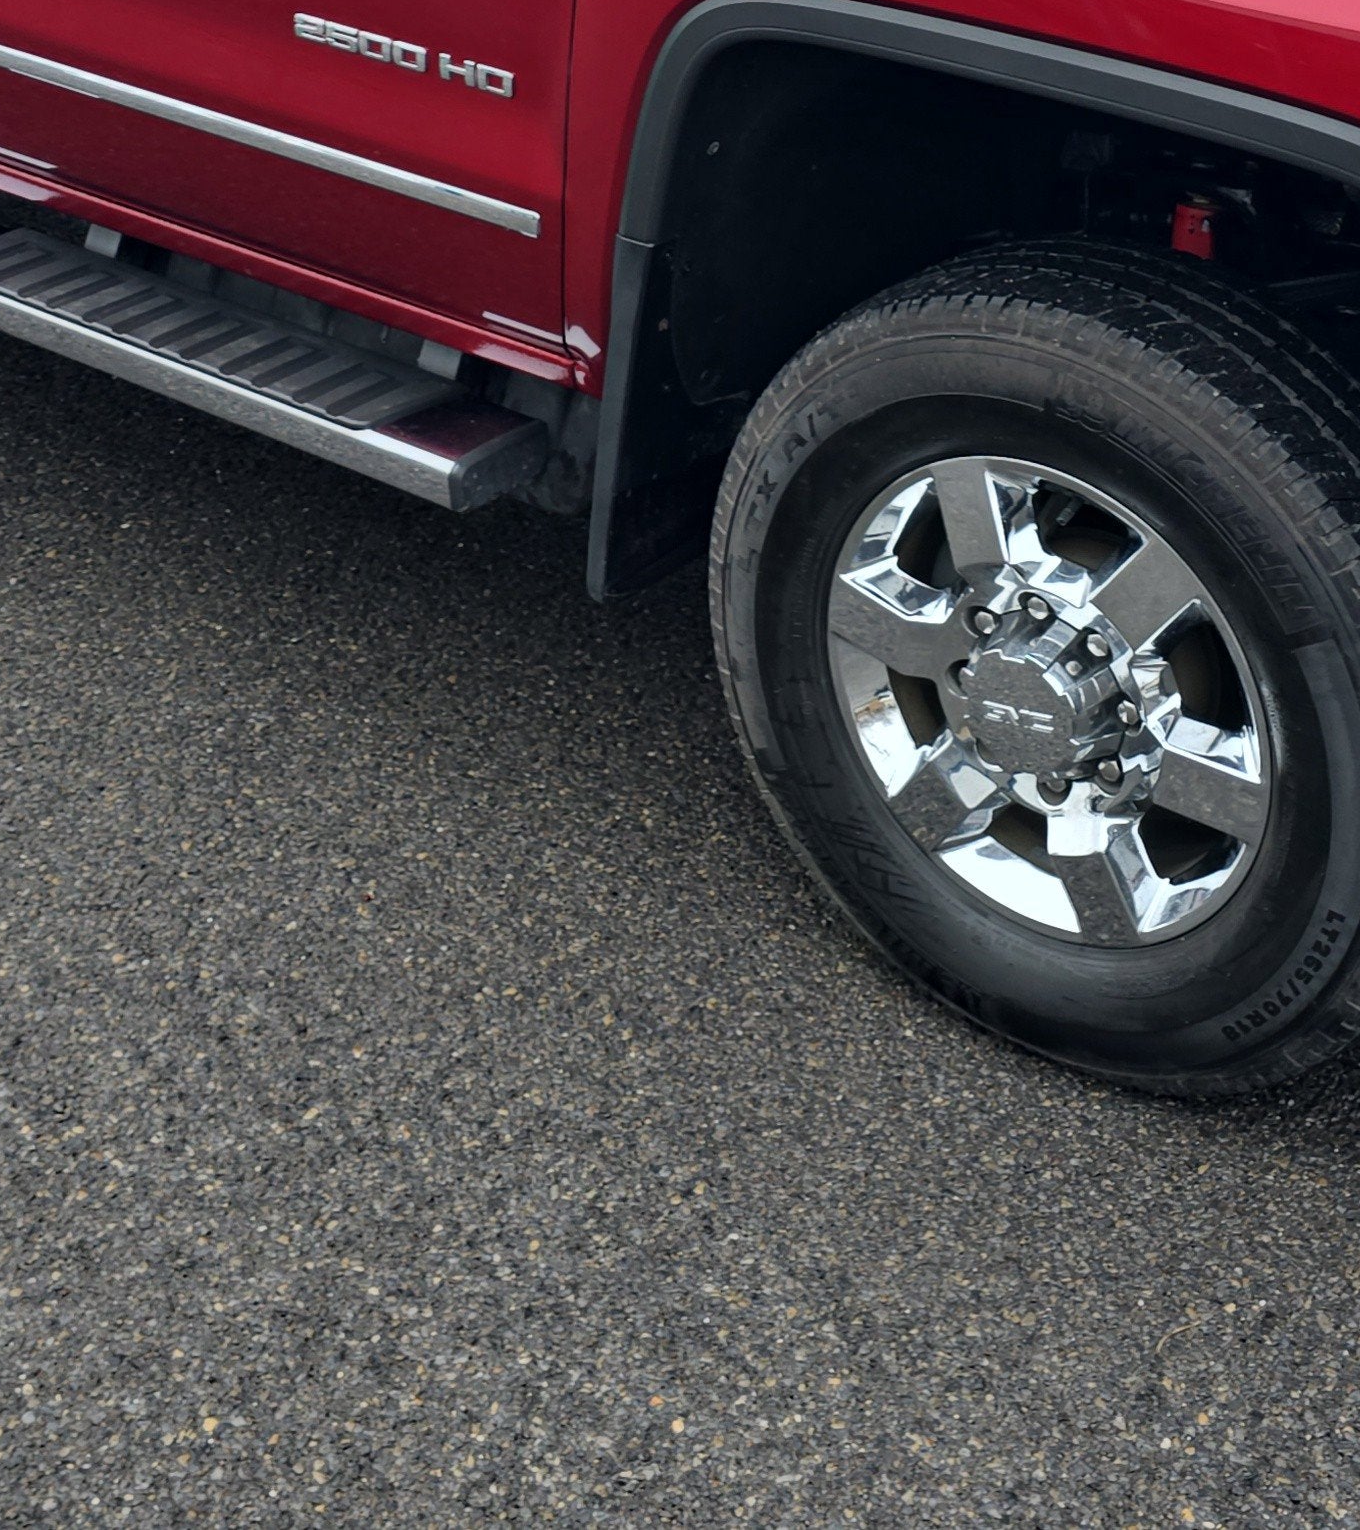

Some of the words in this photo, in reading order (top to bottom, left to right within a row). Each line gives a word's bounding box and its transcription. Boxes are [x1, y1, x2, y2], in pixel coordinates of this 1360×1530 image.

[293, 11, 428, 74] 2500
[438, 52, 515, 99] HD
[1220, 908, 1347, 1042] LT265/70R18
